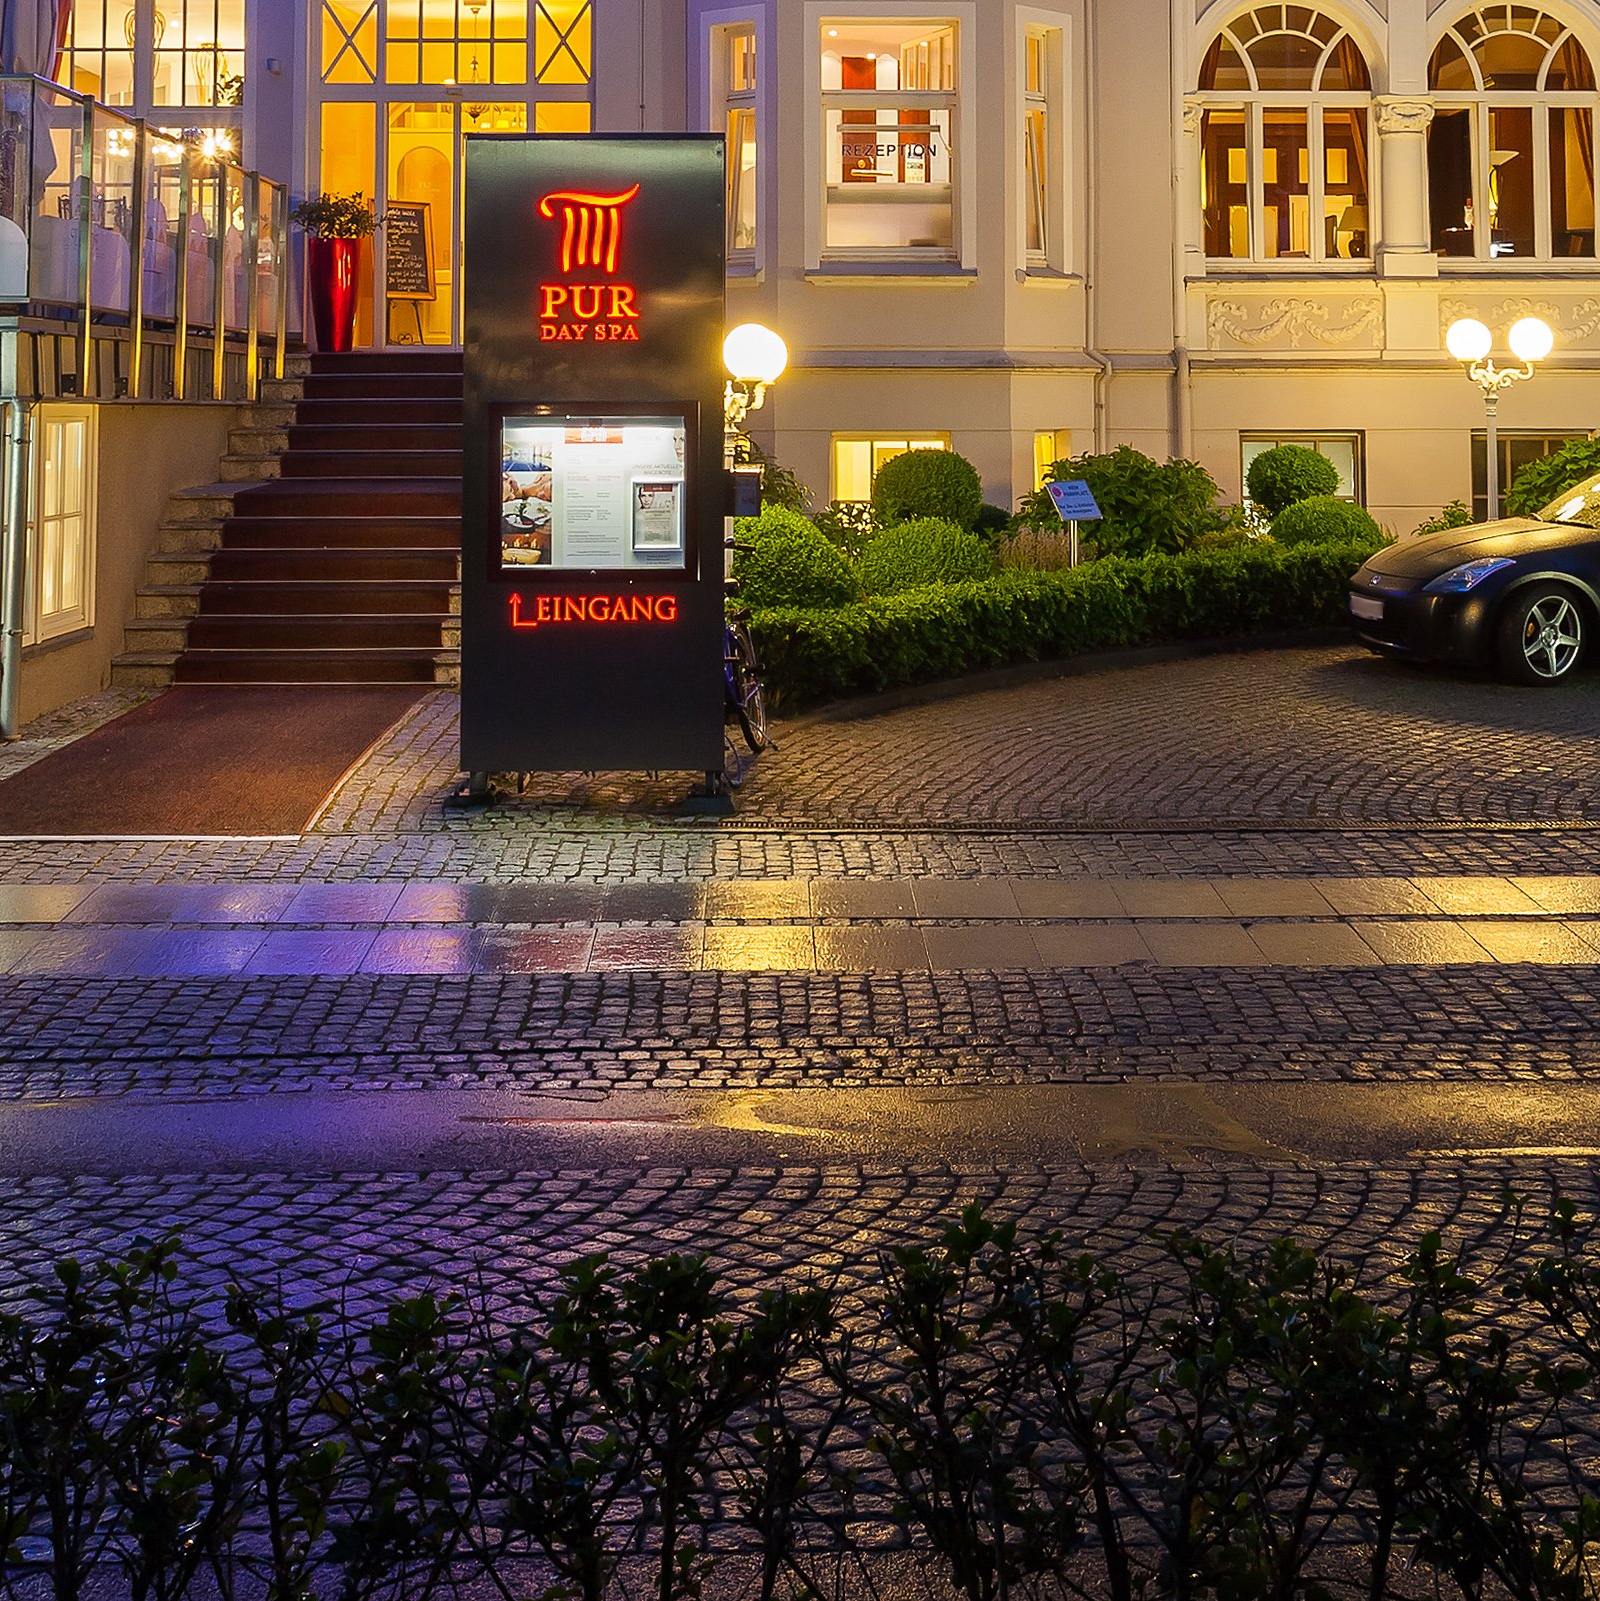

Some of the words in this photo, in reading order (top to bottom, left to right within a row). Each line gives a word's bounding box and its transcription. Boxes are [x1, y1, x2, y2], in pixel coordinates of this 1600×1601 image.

[842, 144, 937, 157] REZEPTION
[540, 285, 639, 318] PUR
[541, 324, 588, 340] DAY
[594, 324, 639, 340] SPA
[537, 596, 677, 621] EINGANG
